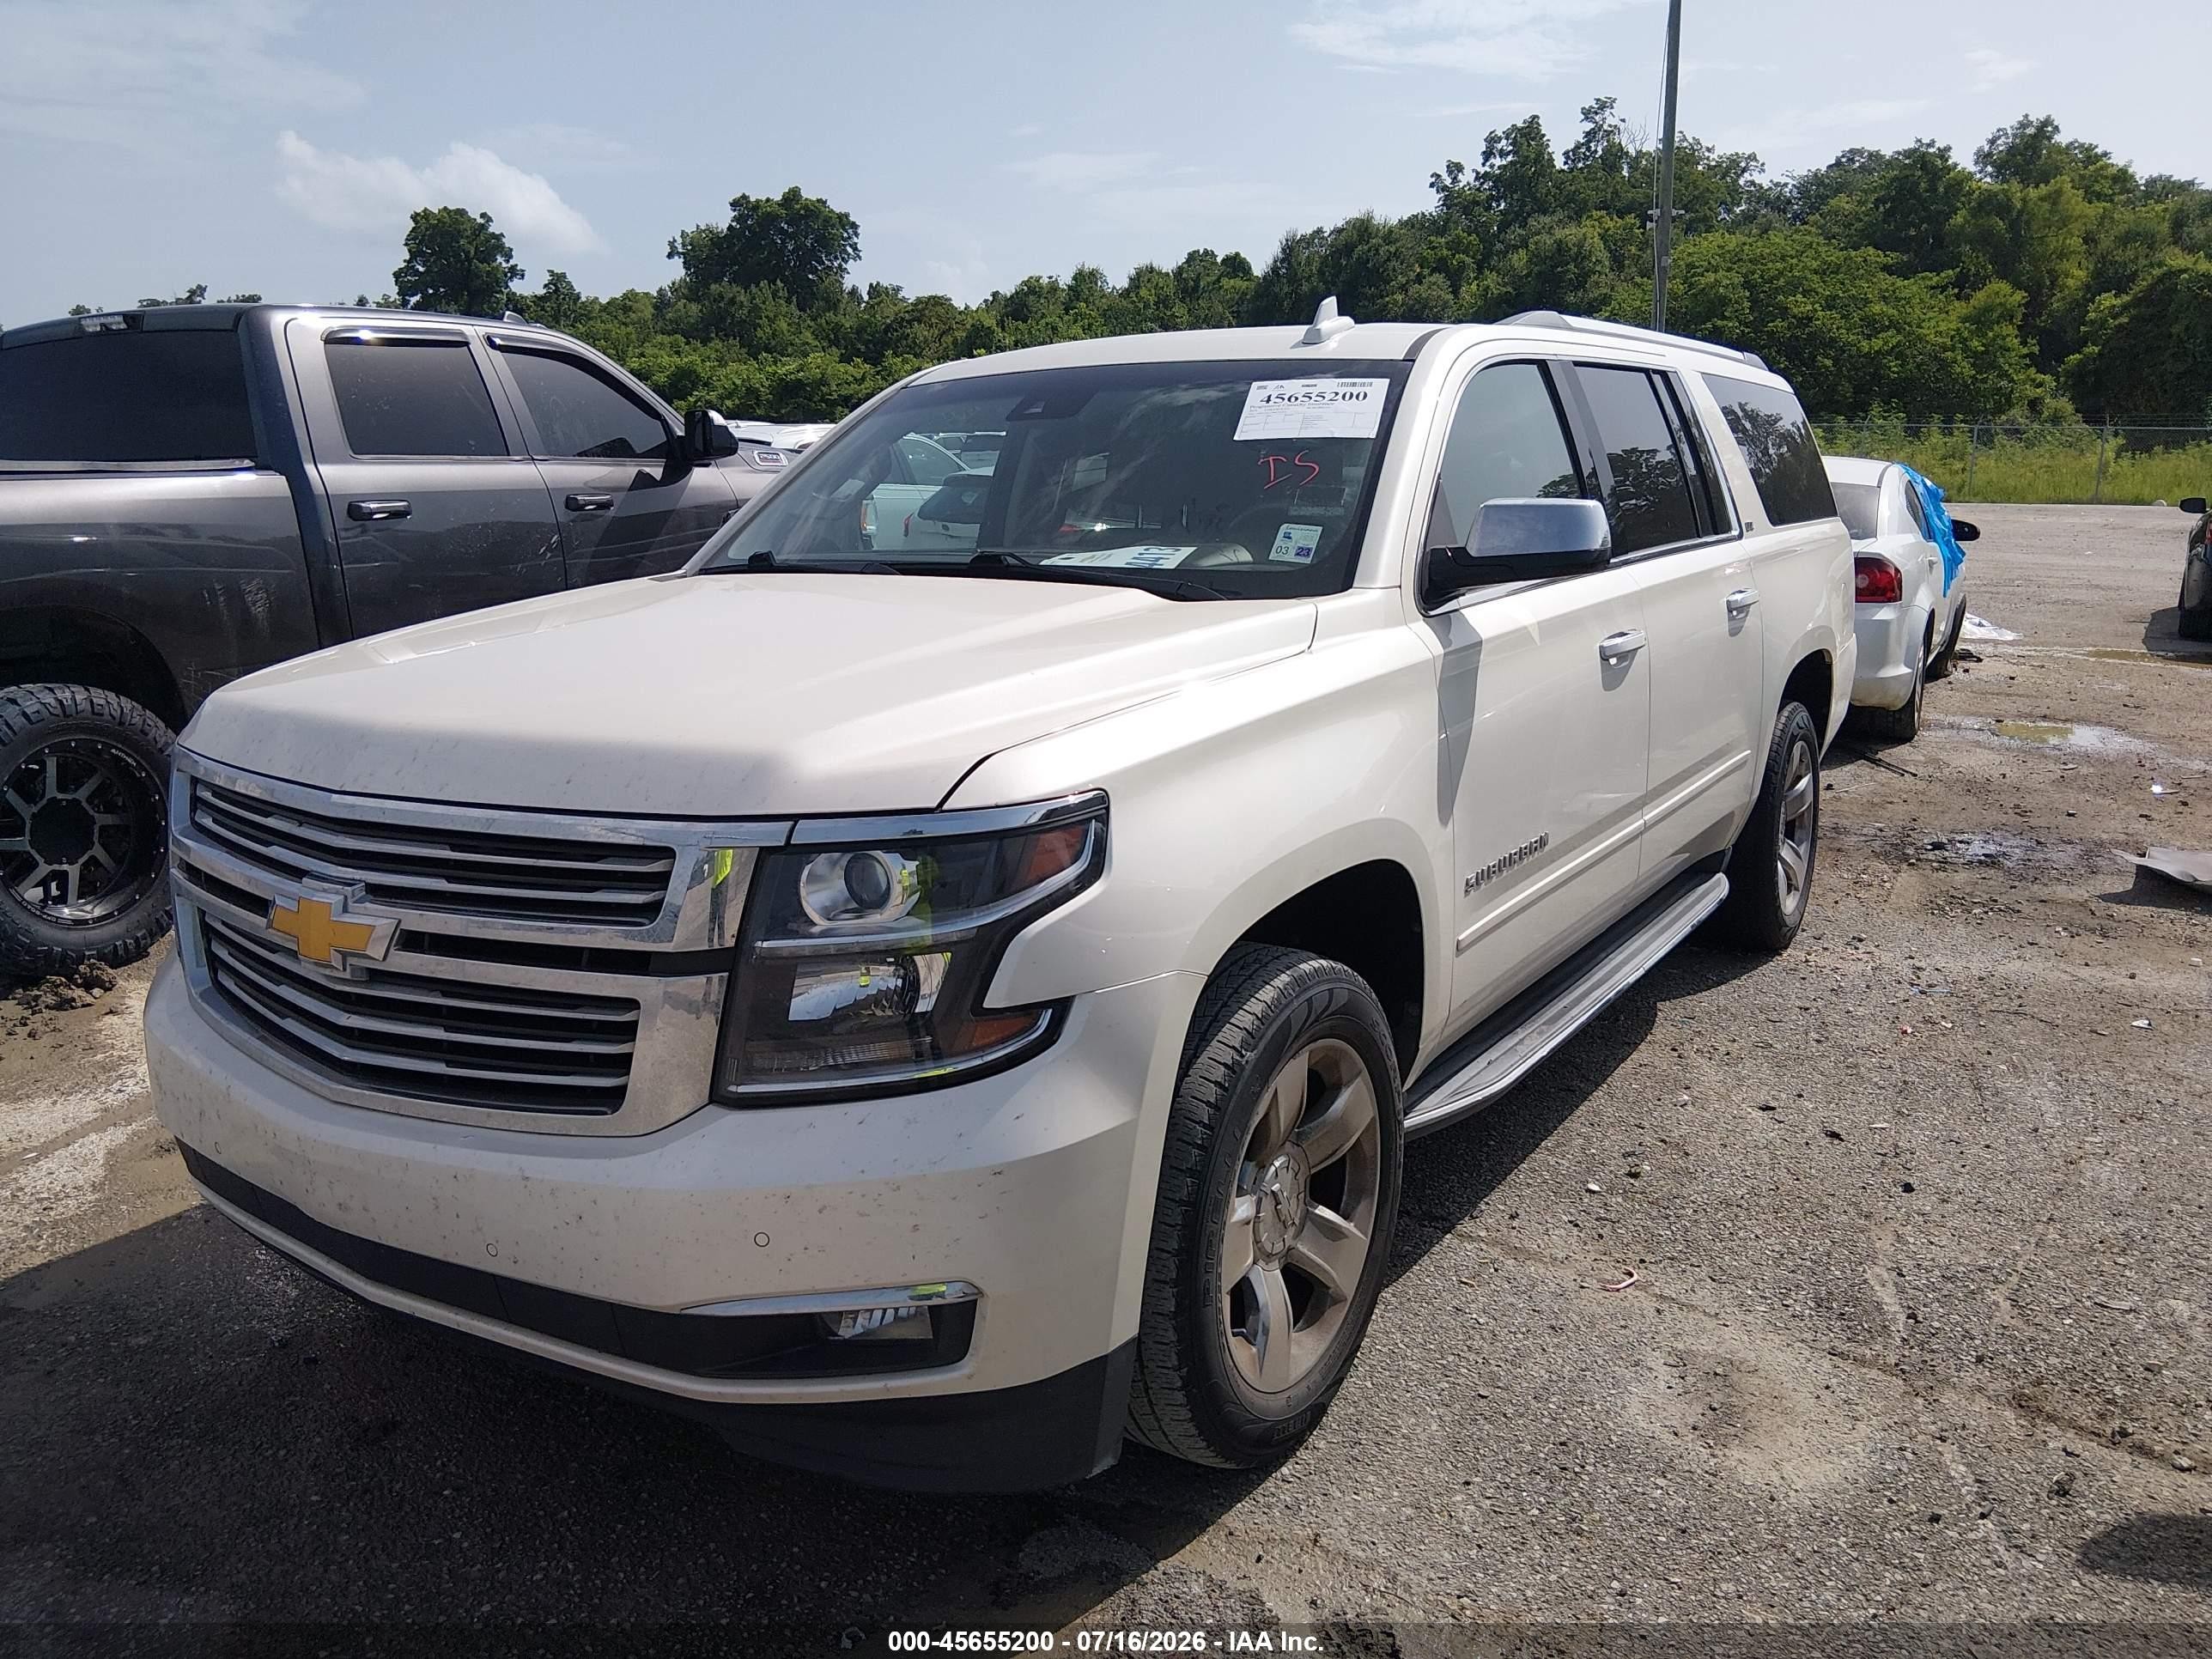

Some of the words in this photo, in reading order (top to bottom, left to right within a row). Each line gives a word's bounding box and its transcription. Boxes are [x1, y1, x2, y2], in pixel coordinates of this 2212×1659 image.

[1259, 391, 1368, 404] 45655200
[1275, 545, 1290, 556] 03
[1297, 547, 1311, 557] 23
[1463, 831, 1549, 897] SUBURBAN
